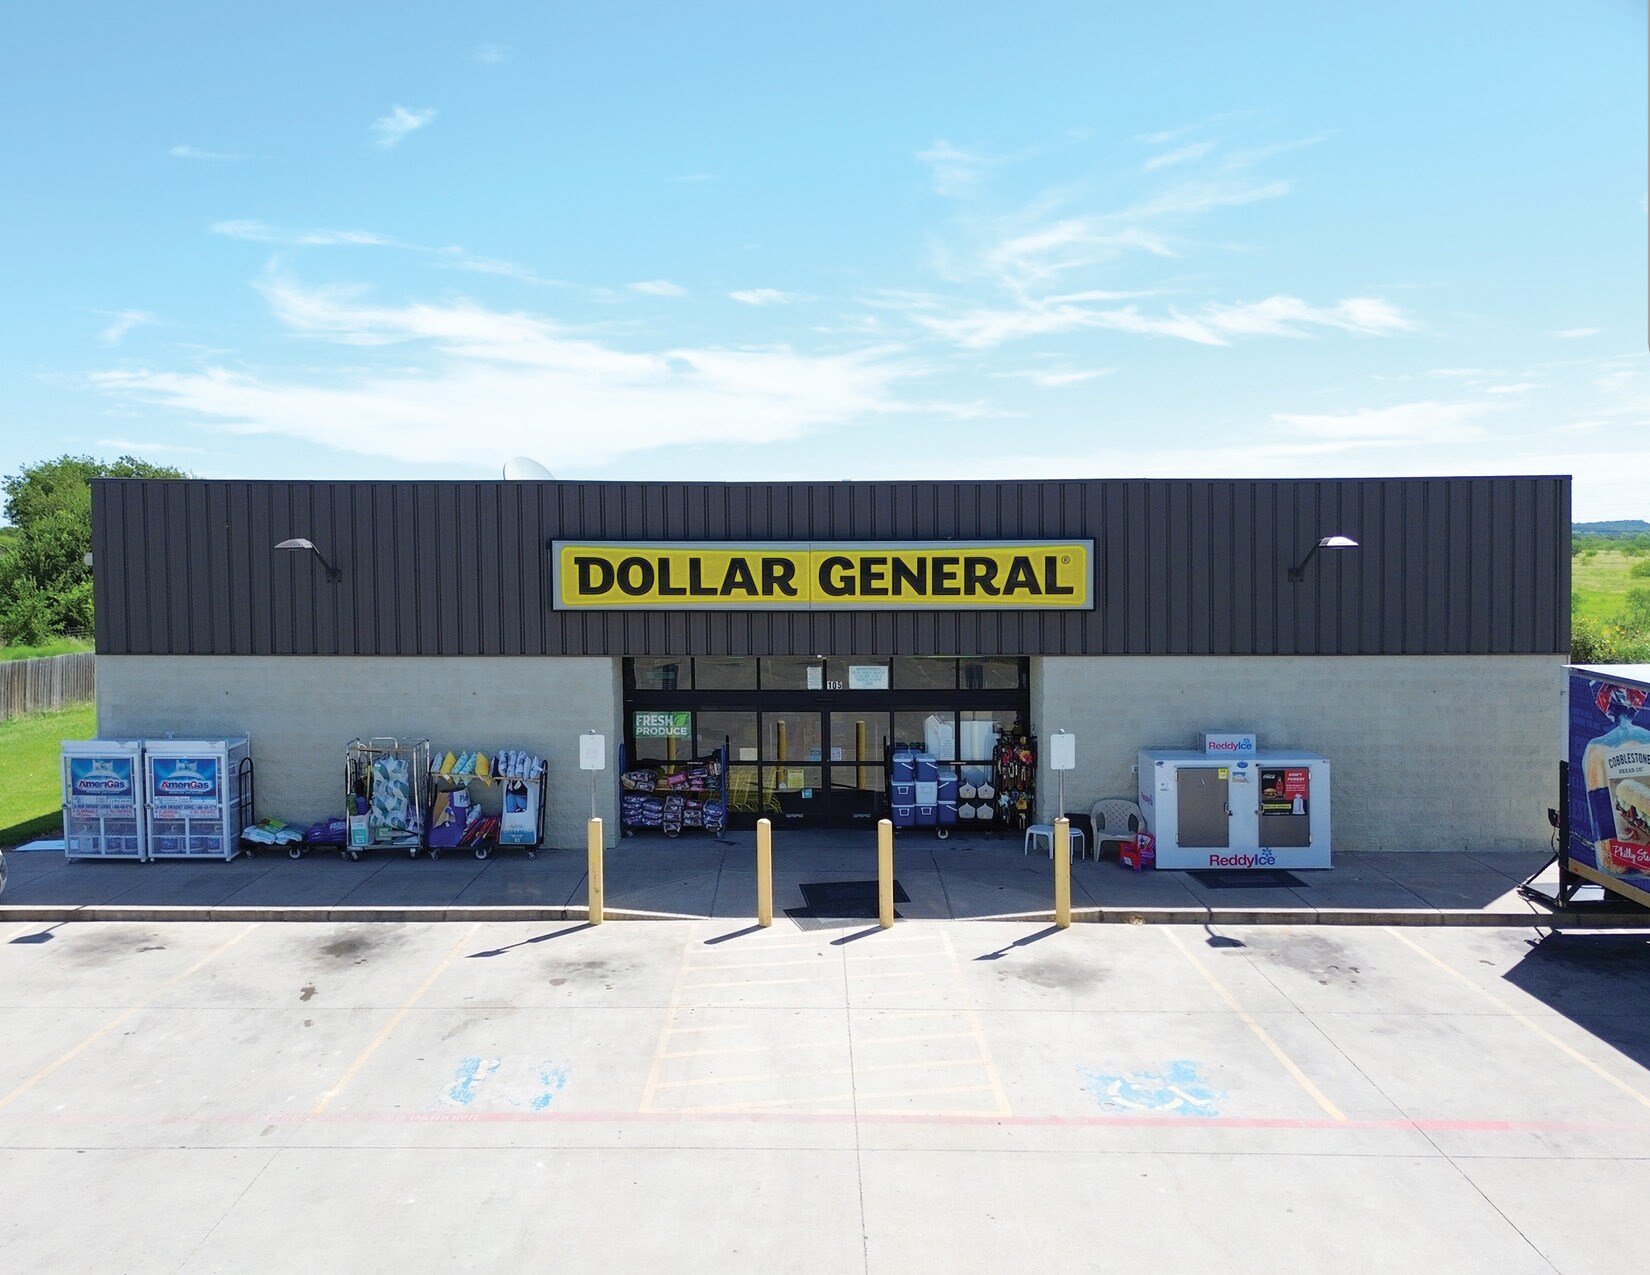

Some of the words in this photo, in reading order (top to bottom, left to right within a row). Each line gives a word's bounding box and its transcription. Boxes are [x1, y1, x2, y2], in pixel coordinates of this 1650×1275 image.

[574, 556, 798, 596] DOLLAR
[817, 555, 1074, 596] GENERAL
[828, 681, 842, 689] 105
[636, 714, 673, 727] FRESH
[636, 727, 687, 736] PRODUCE
[1208, 741, 1253, 752] ReddyIce
[1608, 752, 1650, 769] COBBLESTONE
[79, 780, 125, 789] AmeriGas
[161, 780, 209, 789] AmeriGas
[1612, 845, 1637, 863] Philly
[1209, 853, 1275, 868] ReddyIce
